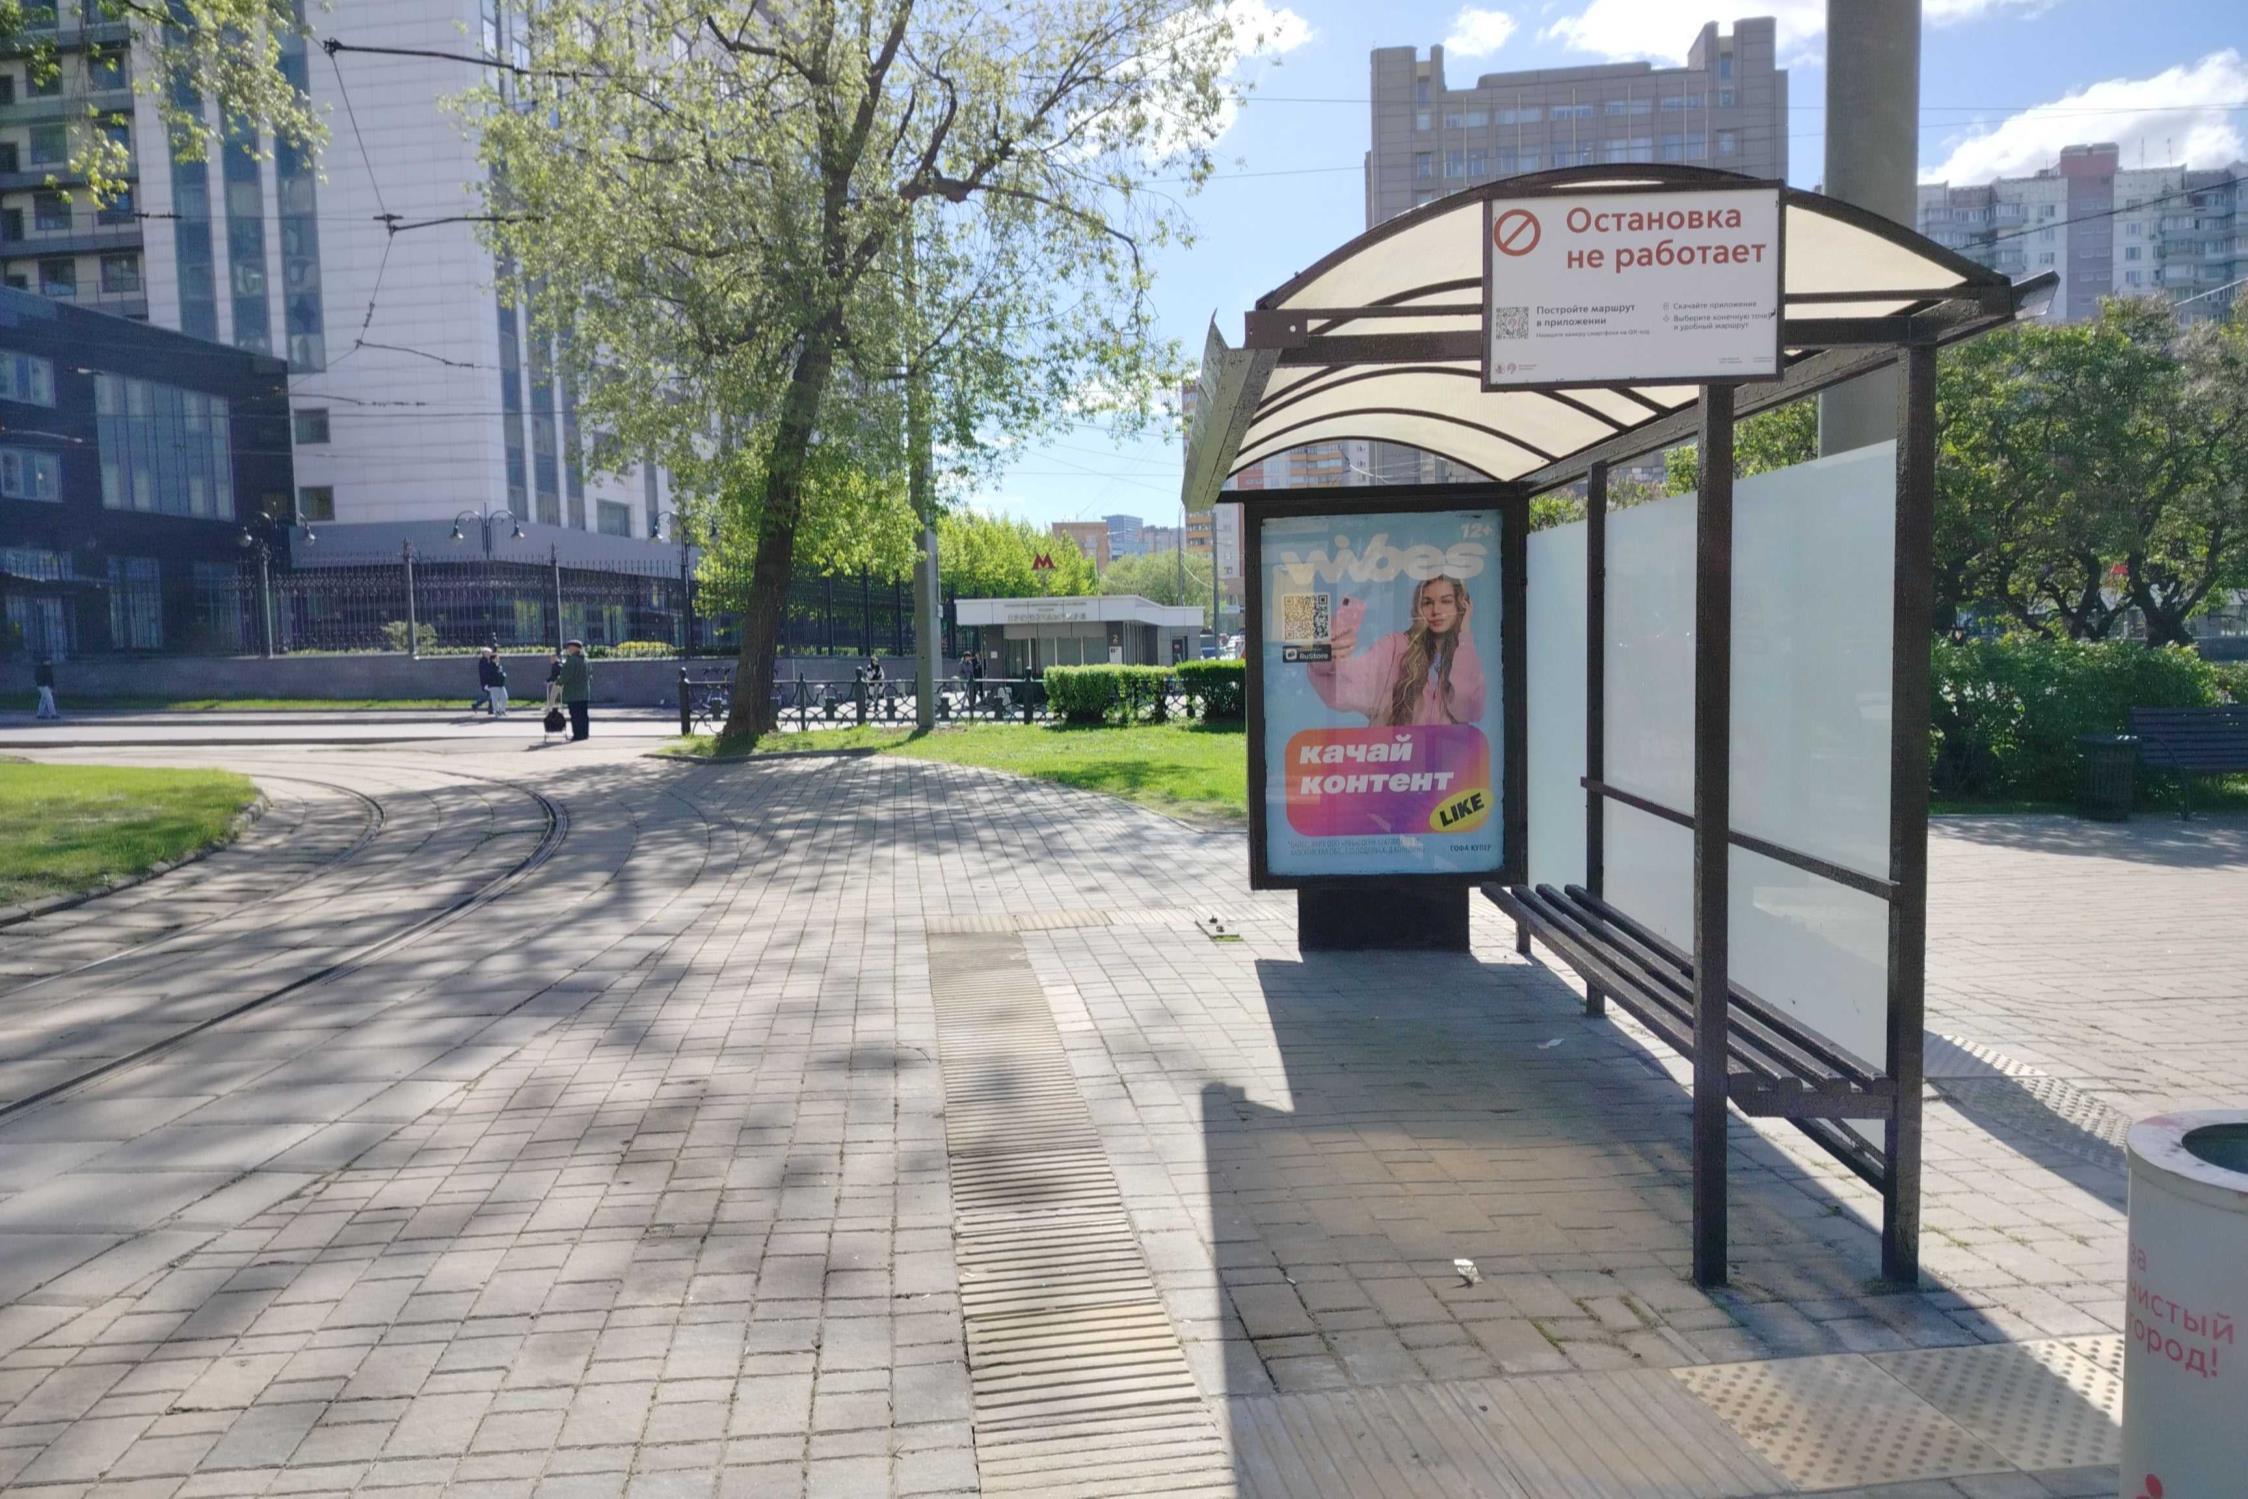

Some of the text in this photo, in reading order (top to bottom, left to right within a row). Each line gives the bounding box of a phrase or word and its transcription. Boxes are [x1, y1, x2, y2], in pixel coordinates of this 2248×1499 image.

[1566, 206, 1742, 234] Остановка
[1567, 239, 1767, 274] не работает
[1536, 304, 1636, 315] Постройте маршрут
[1544, 317, 1607, 328] приложении
[1715, 322, 1749, 331] маршрут
[1299, 733, 1414, 764] качай
[1300, 771, 1455, 795] контент
[1439, 792, 1485, 827] LIKE
